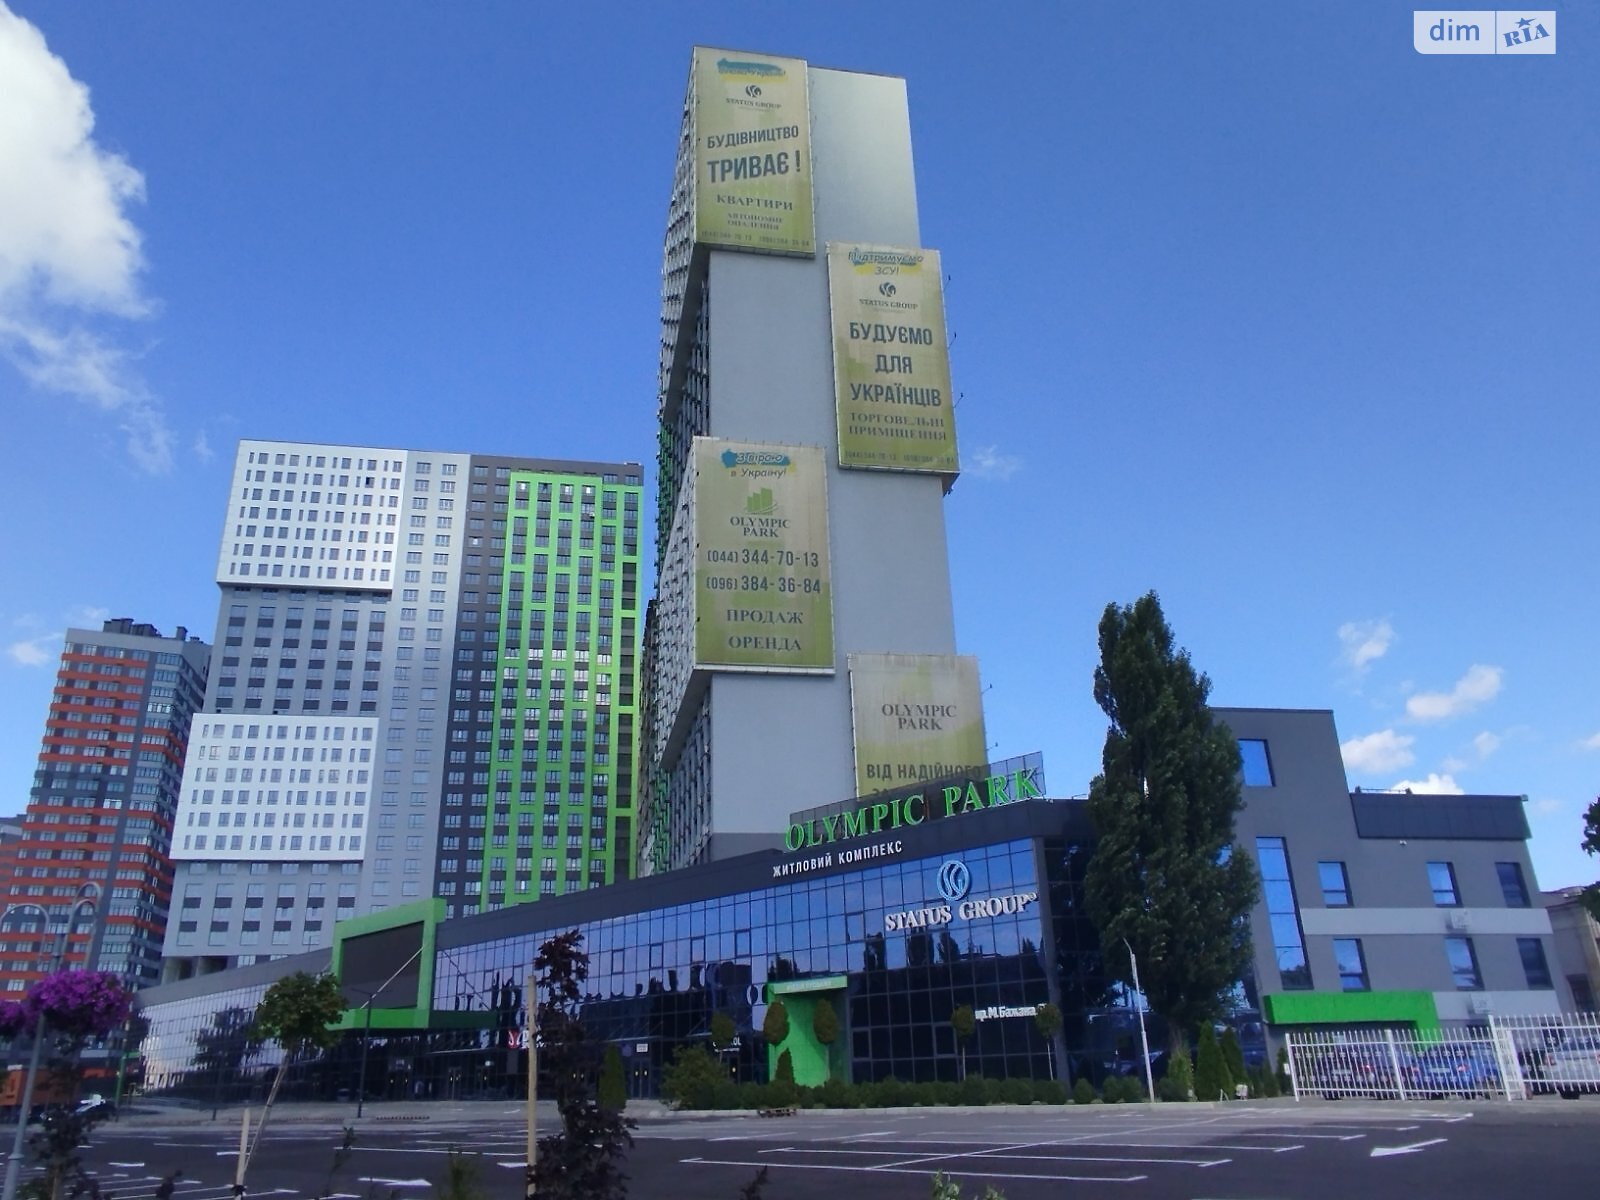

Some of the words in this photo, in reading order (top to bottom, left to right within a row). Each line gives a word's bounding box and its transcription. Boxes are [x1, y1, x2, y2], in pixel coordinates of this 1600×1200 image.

[707, 125, 799, 149] БУДІВНИЦТВО
[717, 194, 793, 211] КВАРТИРИ
[859, 298, 889, 307] STATUS
[890, 302, 918, 310] GROUP
[849, 321, 933, 346] БУДУЄМО
[875, 354, 913, 374] ДЛЯ
[850, 382, 942, 407] УКРАЇНЦІВ
[730, 516, 791, 529] OLYMPIC
[743, 527, 779, 538] PARK
[727, 609, 804, 625] ПРОДАЖ
[728, 635, 802, 651] ОРЕНДА
[881, 703, 957, 718] OLYMPIC
[898, 717, 943, 730] PARK
[866, 763, 892, 781] ВІД
[784, 793, 926, 852] OLYMPIC
[942, 766, 1044, 818] PARK
[772, 852, 833, 878] ЖИТЛОВИЙ
[838, 840, 903, 865] КОМПЛЕКС
[884, 904, 952, 932] STATUS
